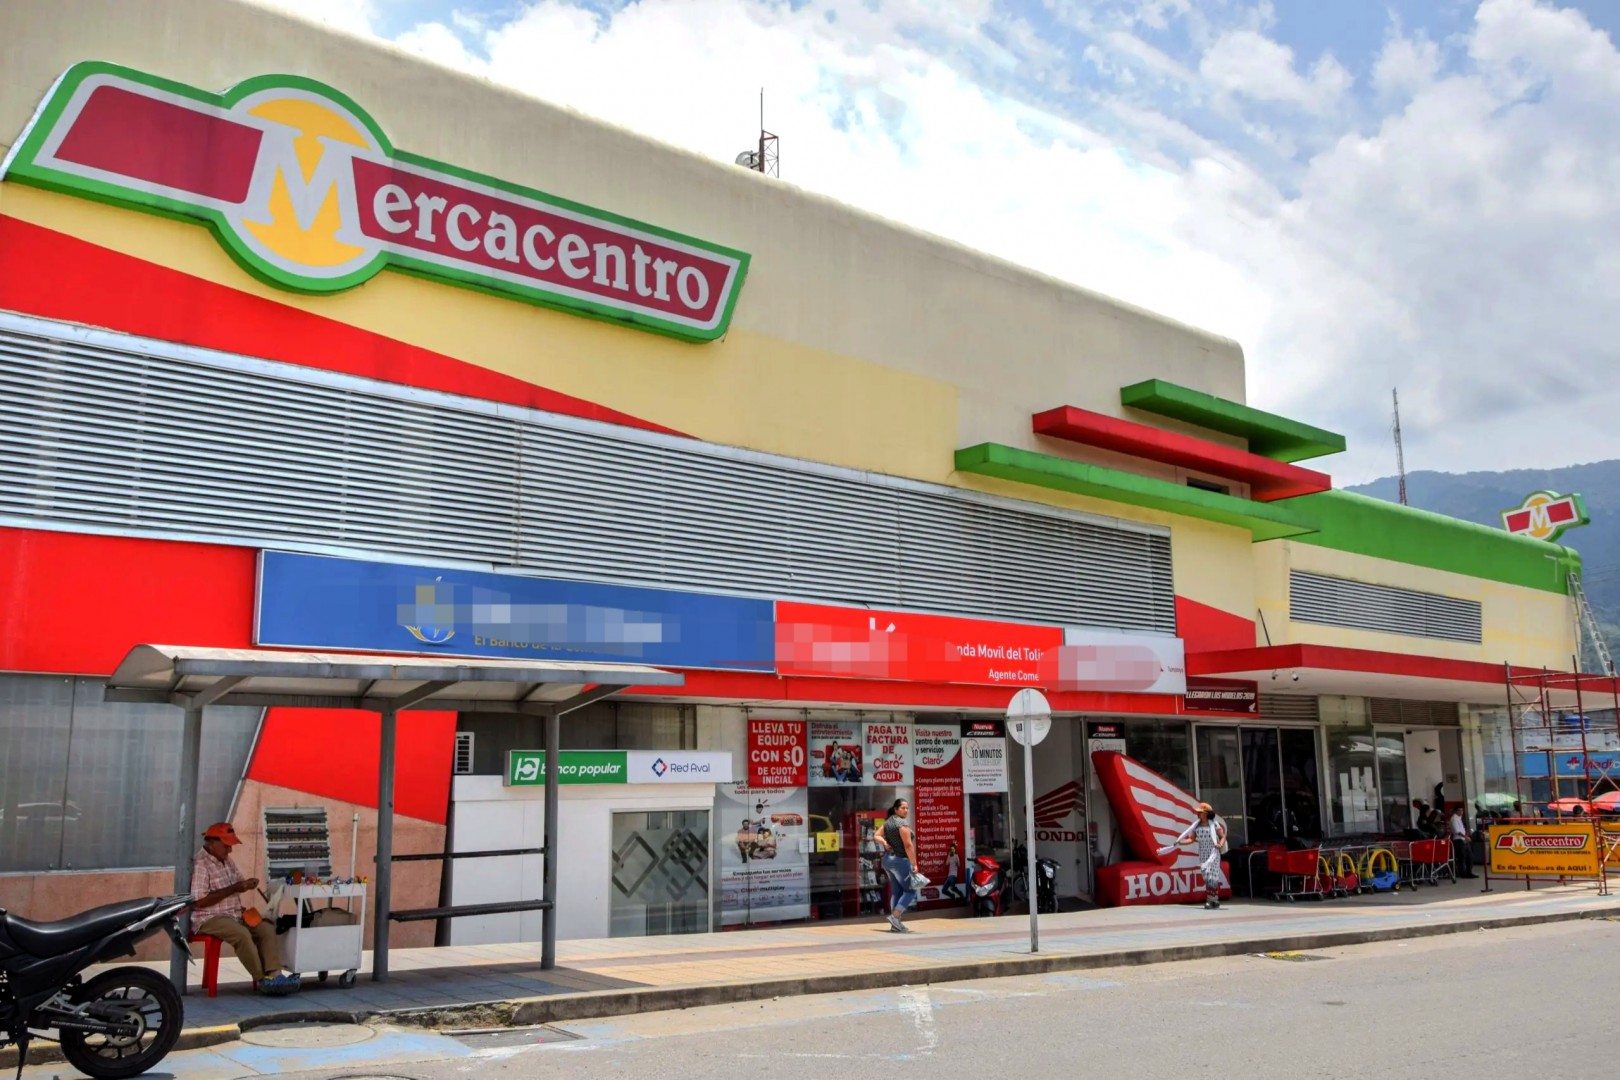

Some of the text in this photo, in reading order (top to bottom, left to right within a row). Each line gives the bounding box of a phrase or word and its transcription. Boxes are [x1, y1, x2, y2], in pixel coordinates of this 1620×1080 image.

[241, 122, 711, 311] Mercacentro
[1526, 504, 1553, 532] M
[978, 645, 1005, 660] Movil
[1006, 648, 1023, 662] del
[988, 668, 1017, 682] Agente
[752, 722, 801, 734] LLEVA TU
[868, 725, 907, 735] PAGA TU
[915, 729, 930, 737] Visita
[757, 735, 797, 746] EQUIPO
[867, 735, 909, 745] FACTURA
[882, 745, 894, 754] DE
[920, 746, 945, 754] servicios
[972, 749, 1002, 759] 10 MINUTOS
[751, 750, 780, 763] CON
[922, 756, 940, 765] Claro
[670, 762, 711, 773] Red Aval
[873, 757, 901, 770] Claro
[540, 761, 622, 778] bnco popular
[757, 767, 798, 776] DE CUOTA
[762, 775, 793, 784] INICIAL
[1512, 835, 1581, 848] Mercacentro
